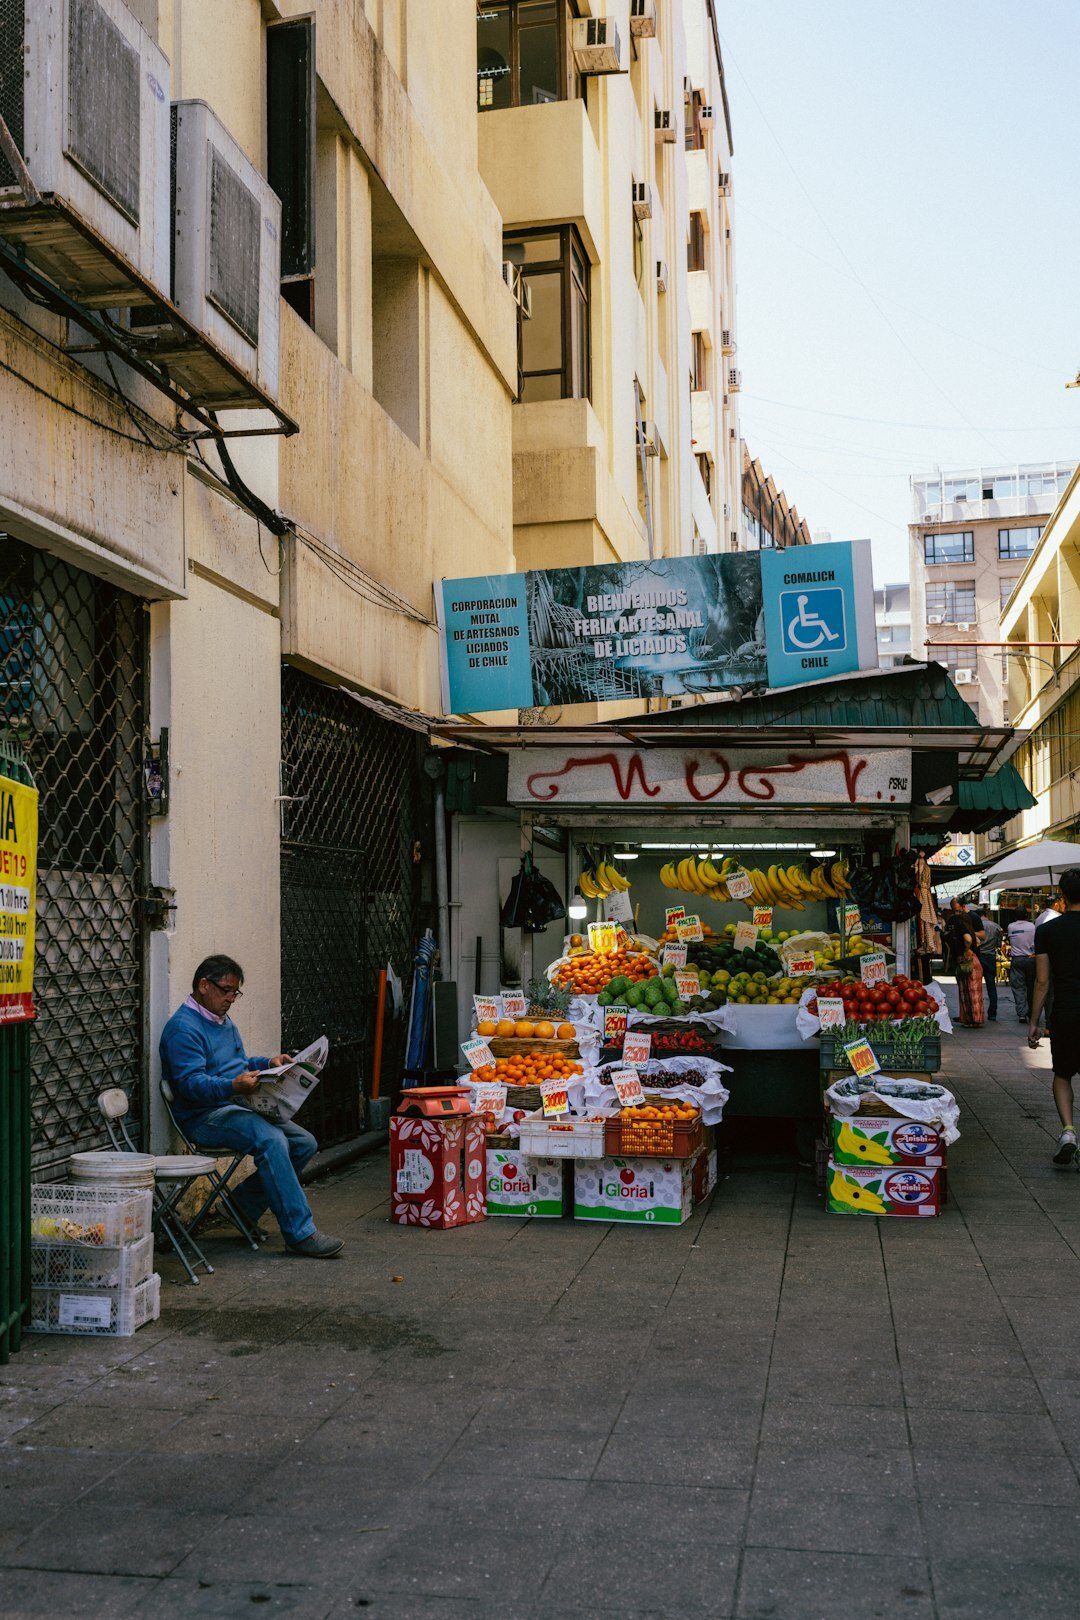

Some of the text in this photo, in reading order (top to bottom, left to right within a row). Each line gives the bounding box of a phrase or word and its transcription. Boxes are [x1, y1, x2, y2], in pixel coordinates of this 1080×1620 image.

[784, 571, 835, 584] COMALICH
[452, 598, 517, 612] CORPORACION
[587, 589, 688, 613] BIENVENIDOS
[471, 614, 500, 625] MUTAL
[574, 610, 704, 637] FERIA ARTESANAL
[454, 626, 520, 640] DE ARTESANOS
[467, 641, 508, 654] LICIADOS
[594, 635, 687, 658] DE LICIADOS
[469, 656, 508, 667] DE CHILE
[801, 657, 829, 668] CHILE
[861, 954, 884, 963] REGALO
[617, 1080, 641, 1099] 3000
[896, 1134, 928, 1143] Anishi
[488, 1178, 530, 1192] Gloria
[605, 1183, 648, 1198] Gloria
[889, 1183, 921, 1192] Anishi
